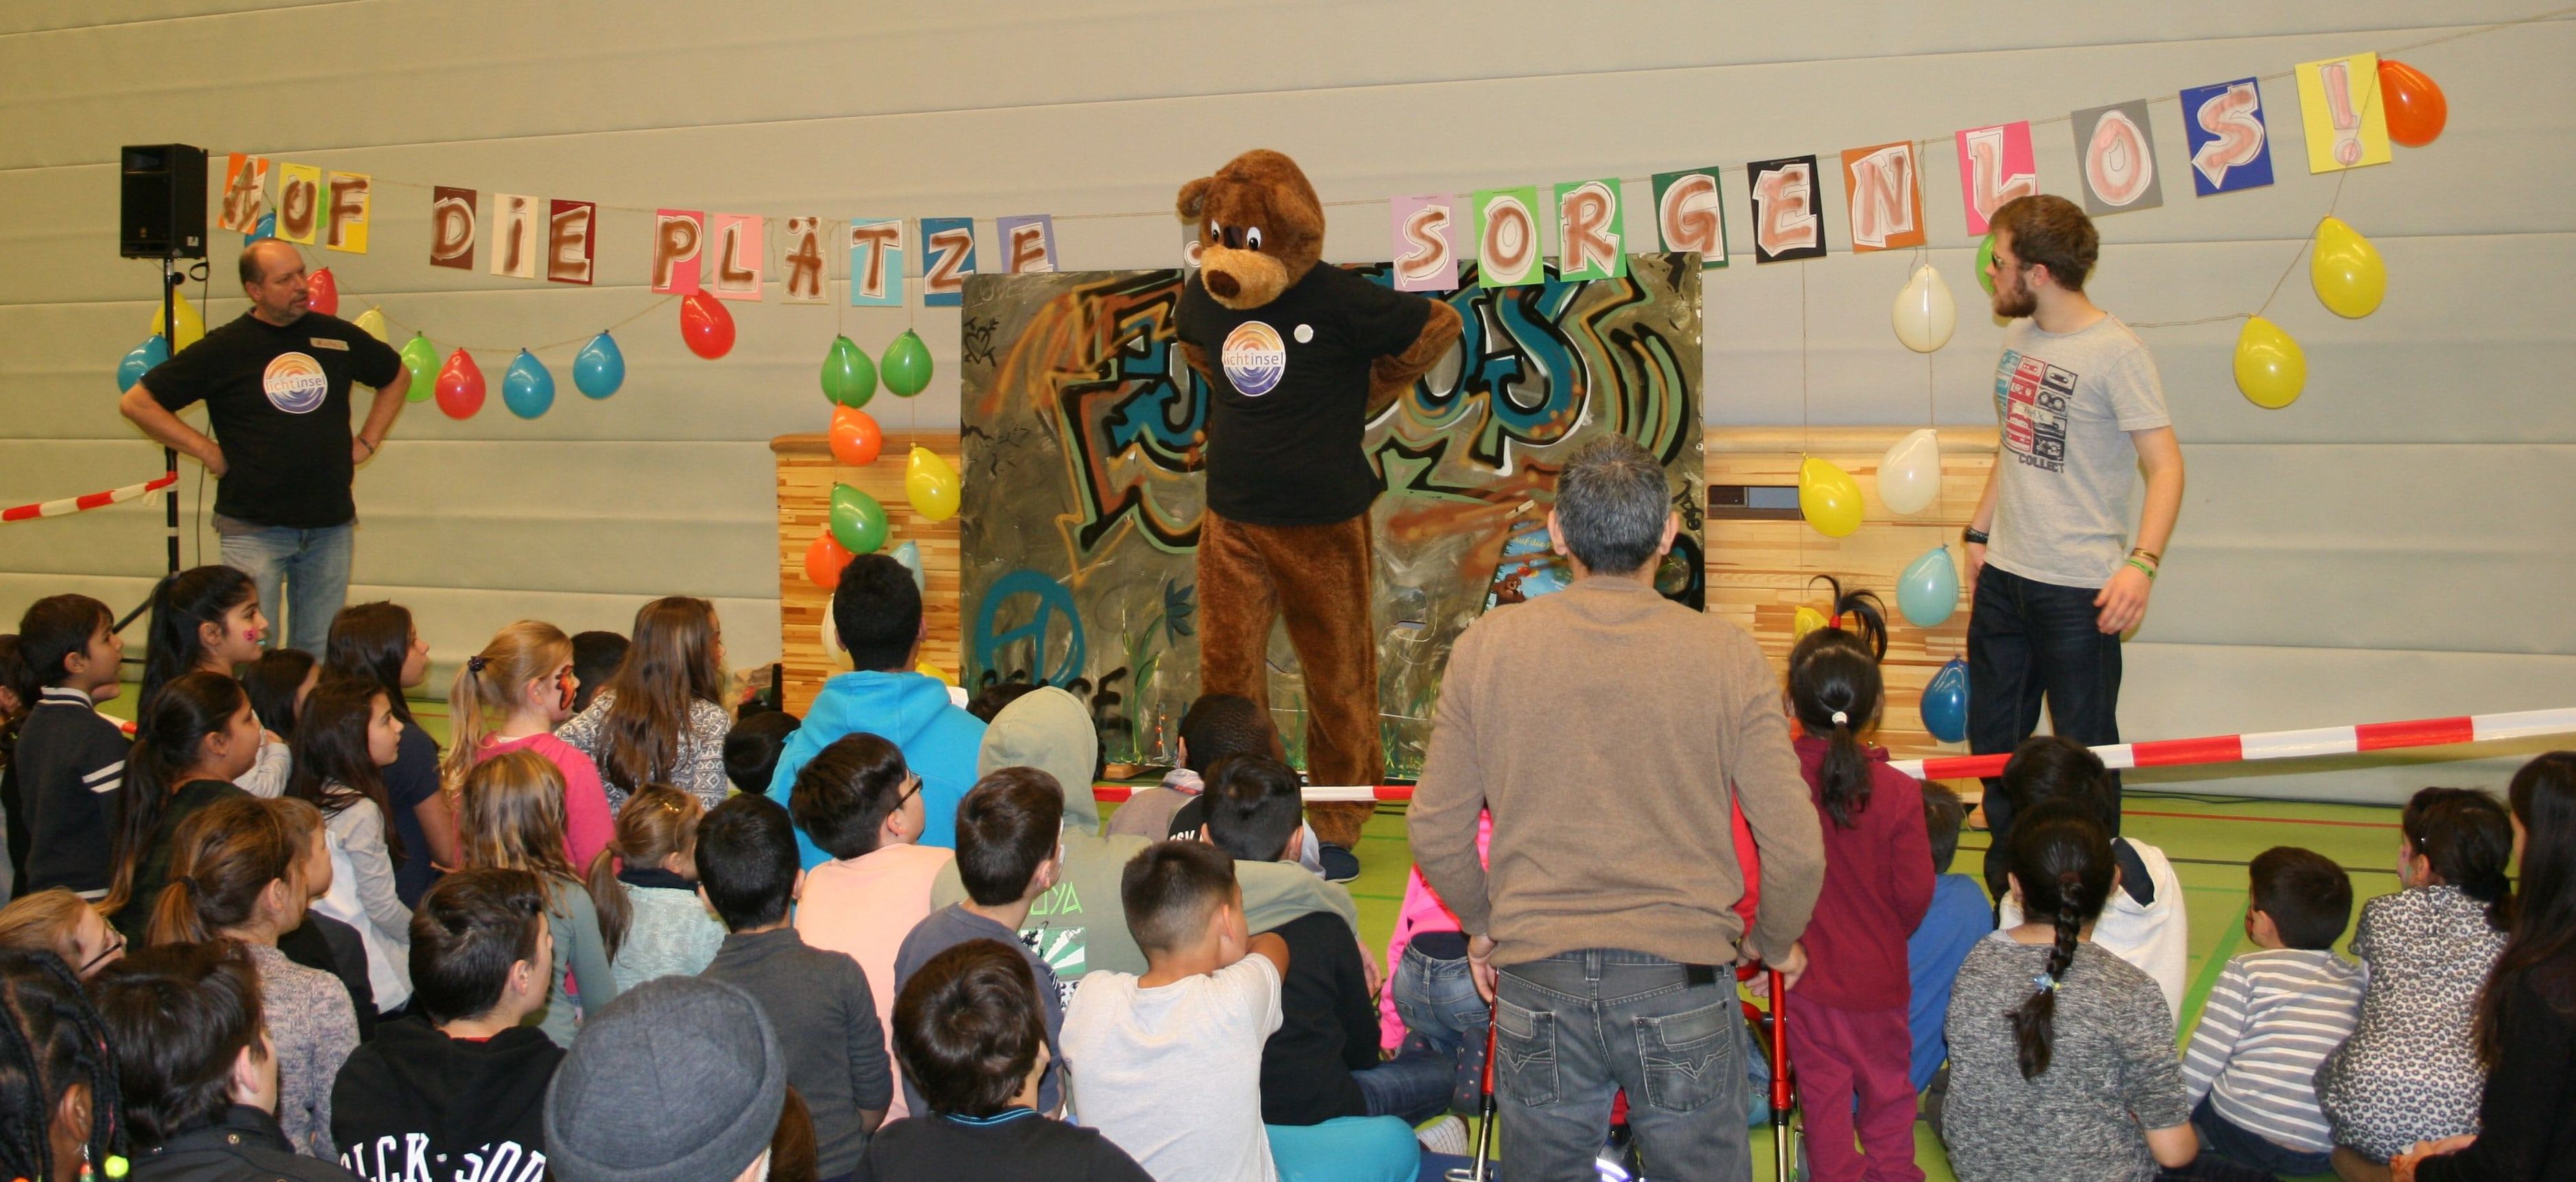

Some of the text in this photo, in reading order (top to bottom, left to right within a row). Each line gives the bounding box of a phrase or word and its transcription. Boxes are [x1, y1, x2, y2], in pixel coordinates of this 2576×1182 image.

[223, 156, 369, 247] AUF
[1223, 351, 1284, 366] lichtinsel
[2019, 454, 2065, 474] COLLECT
